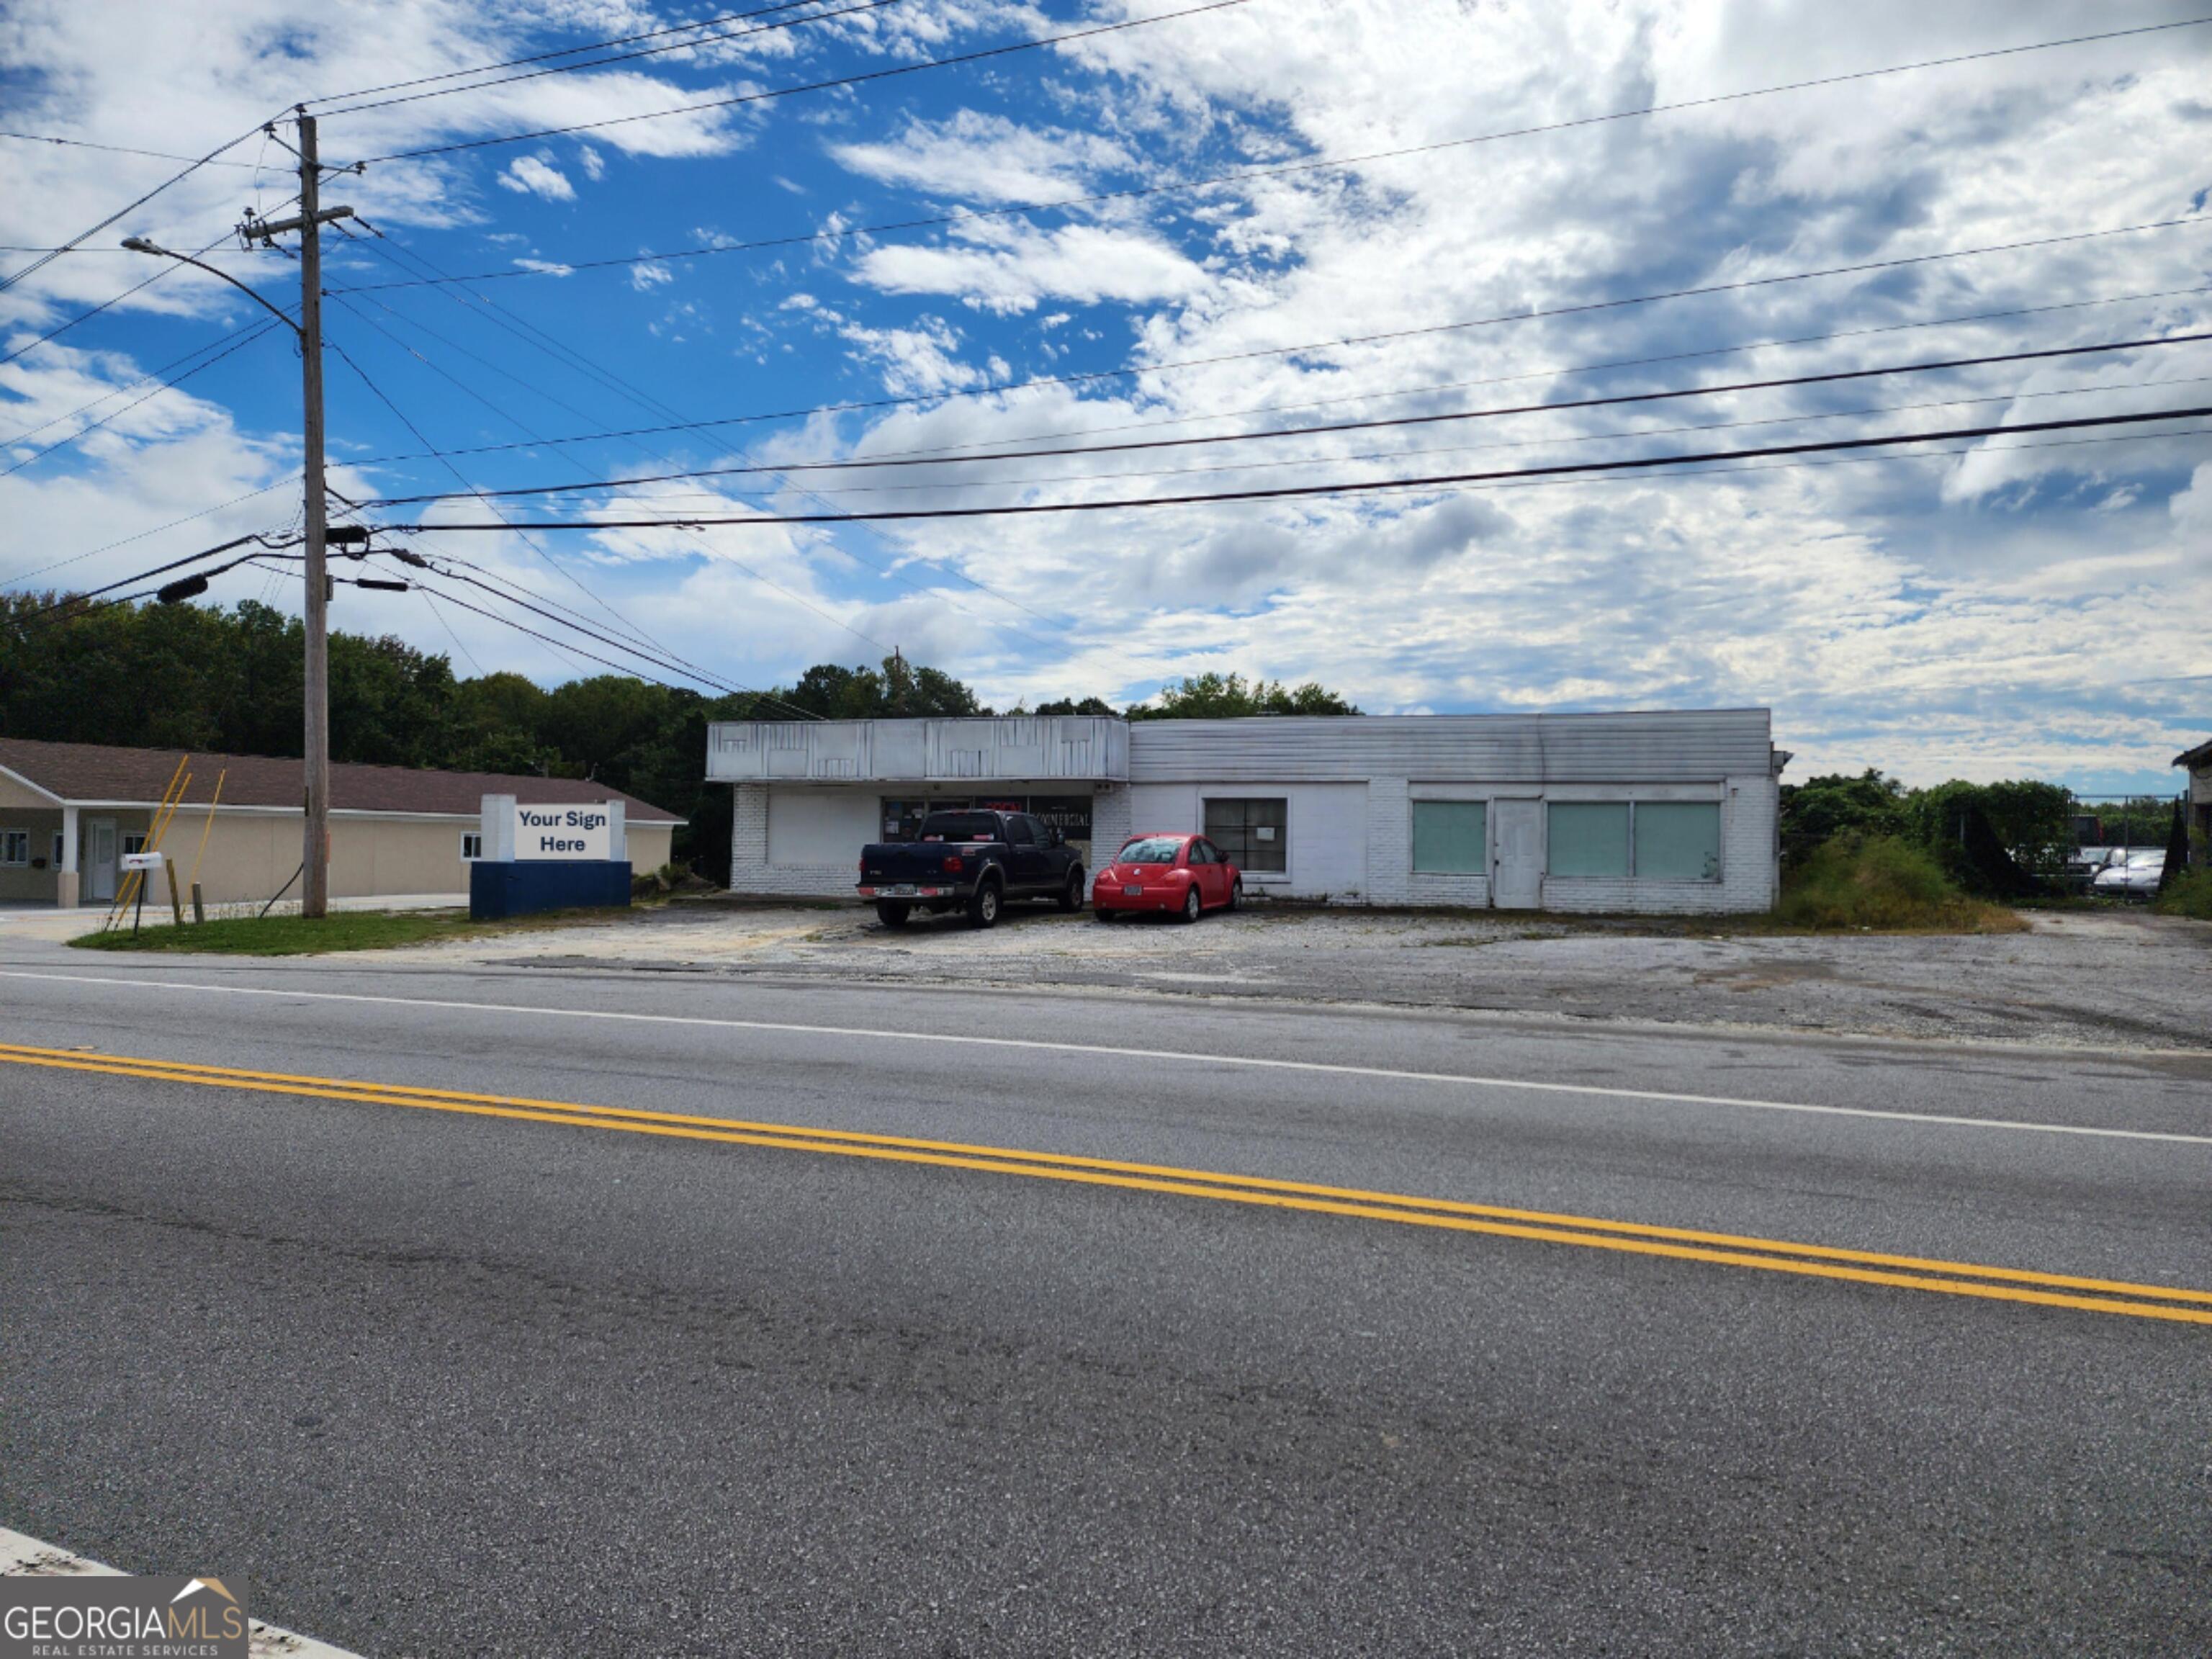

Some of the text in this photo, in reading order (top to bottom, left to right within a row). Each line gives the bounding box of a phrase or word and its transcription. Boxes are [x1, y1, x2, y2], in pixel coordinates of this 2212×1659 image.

[519, 810, 606, 830] Your Sign
[1035, 812, 1089, 827] OMMERCIAL
[540, 836, 585, 852] Here
